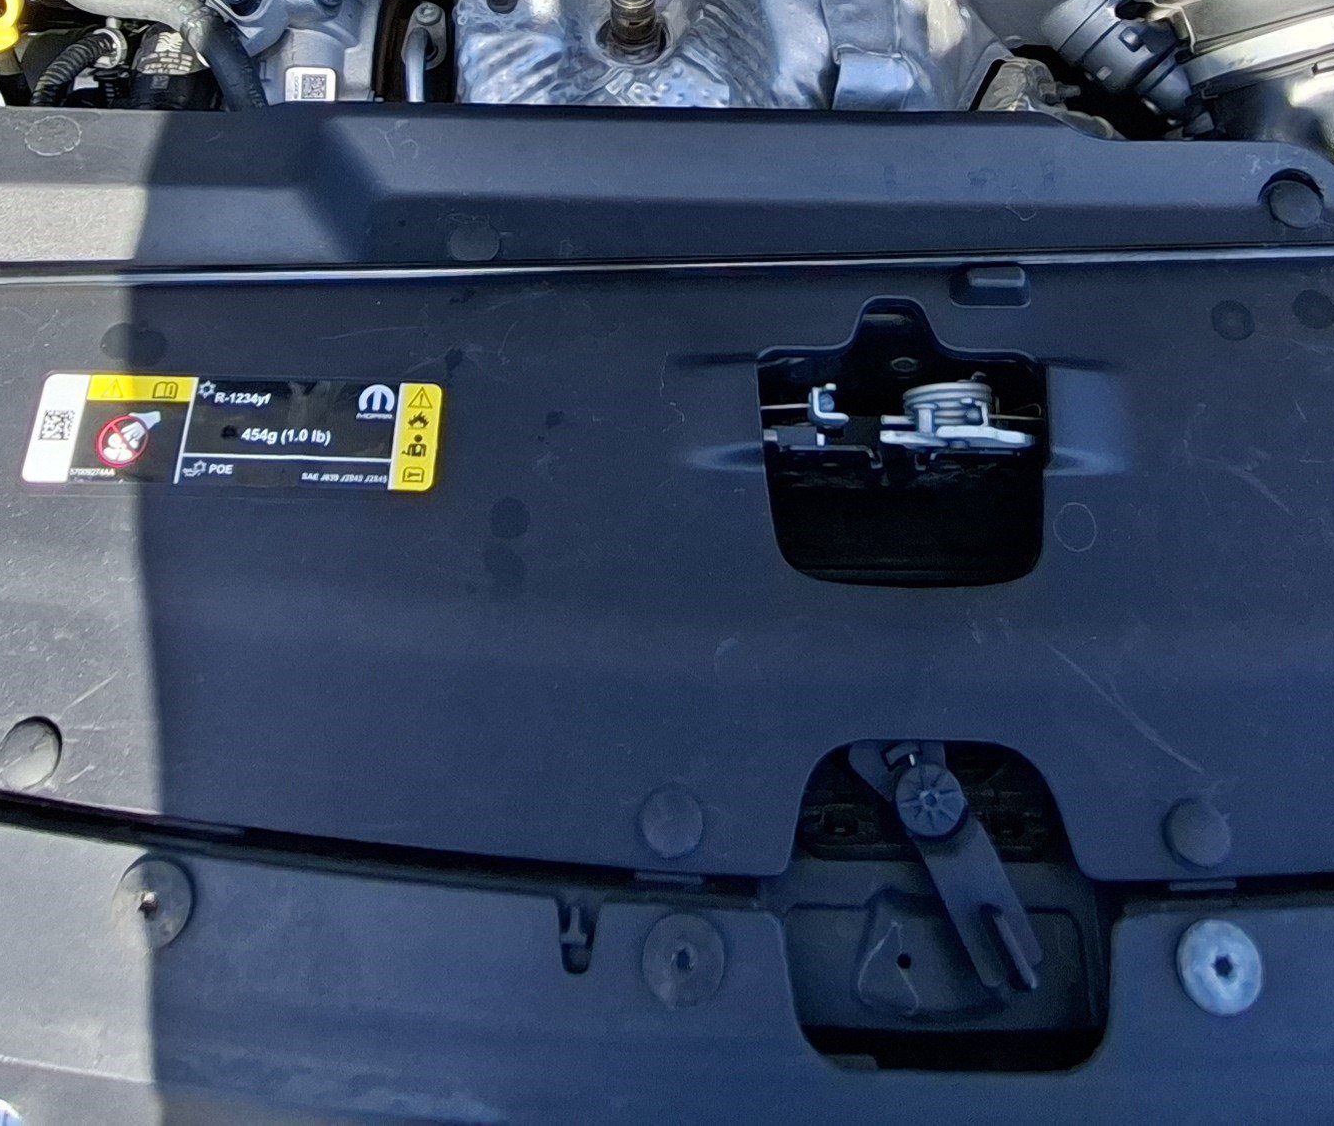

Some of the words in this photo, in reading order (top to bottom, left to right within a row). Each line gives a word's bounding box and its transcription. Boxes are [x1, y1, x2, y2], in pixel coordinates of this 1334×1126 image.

[214, 392, 272, 407] R-1234yf
[240, 427, 278, 445] 454g
[280, 428, 309, 447] (1.0
[310, 428, 332, 447] lb)
[208, 463, 234, 475] POE
[301, 472, 319, 481] SAE
